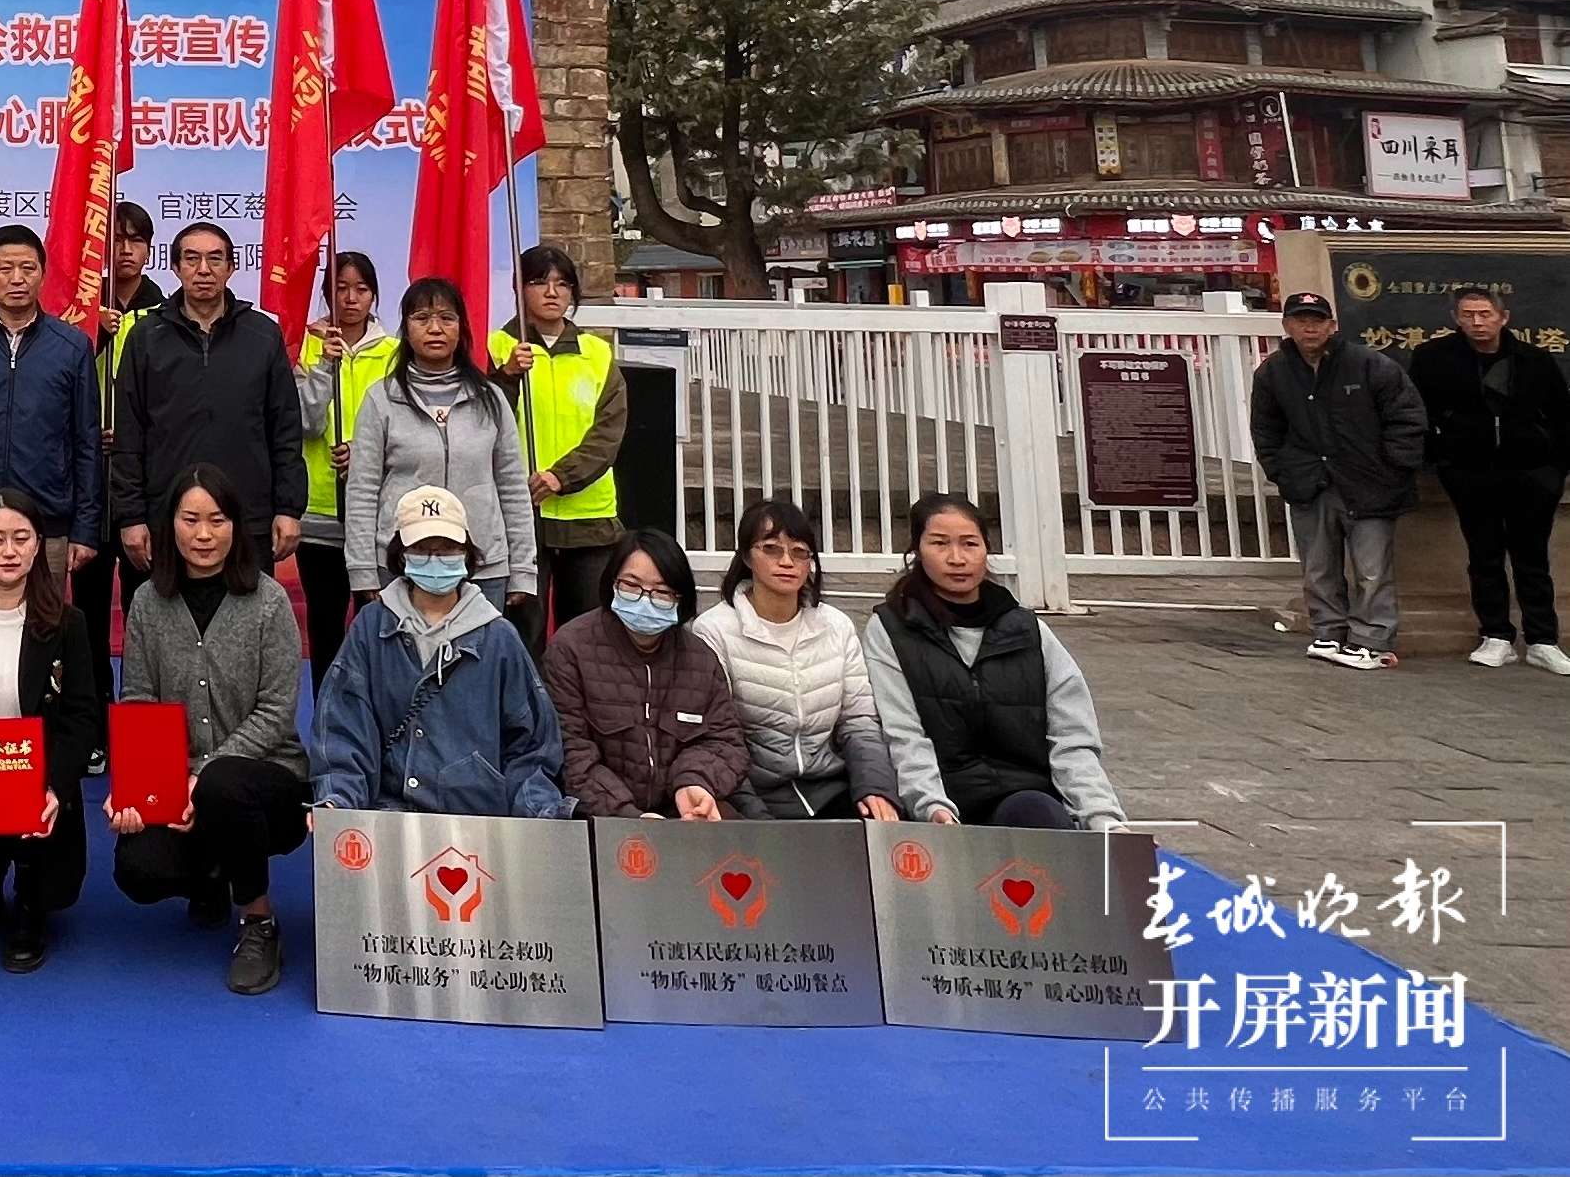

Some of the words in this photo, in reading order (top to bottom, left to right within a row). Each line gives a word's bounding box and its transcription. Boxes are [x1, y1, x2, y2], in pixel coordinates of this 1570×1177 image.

[361, 932, 554, 963] 官渡区民政局社会救助
[647, 941, 835, 964] 官渡区民政局社会救助
[927, 944, 1129, 977] 官渡区民政局社会救助
